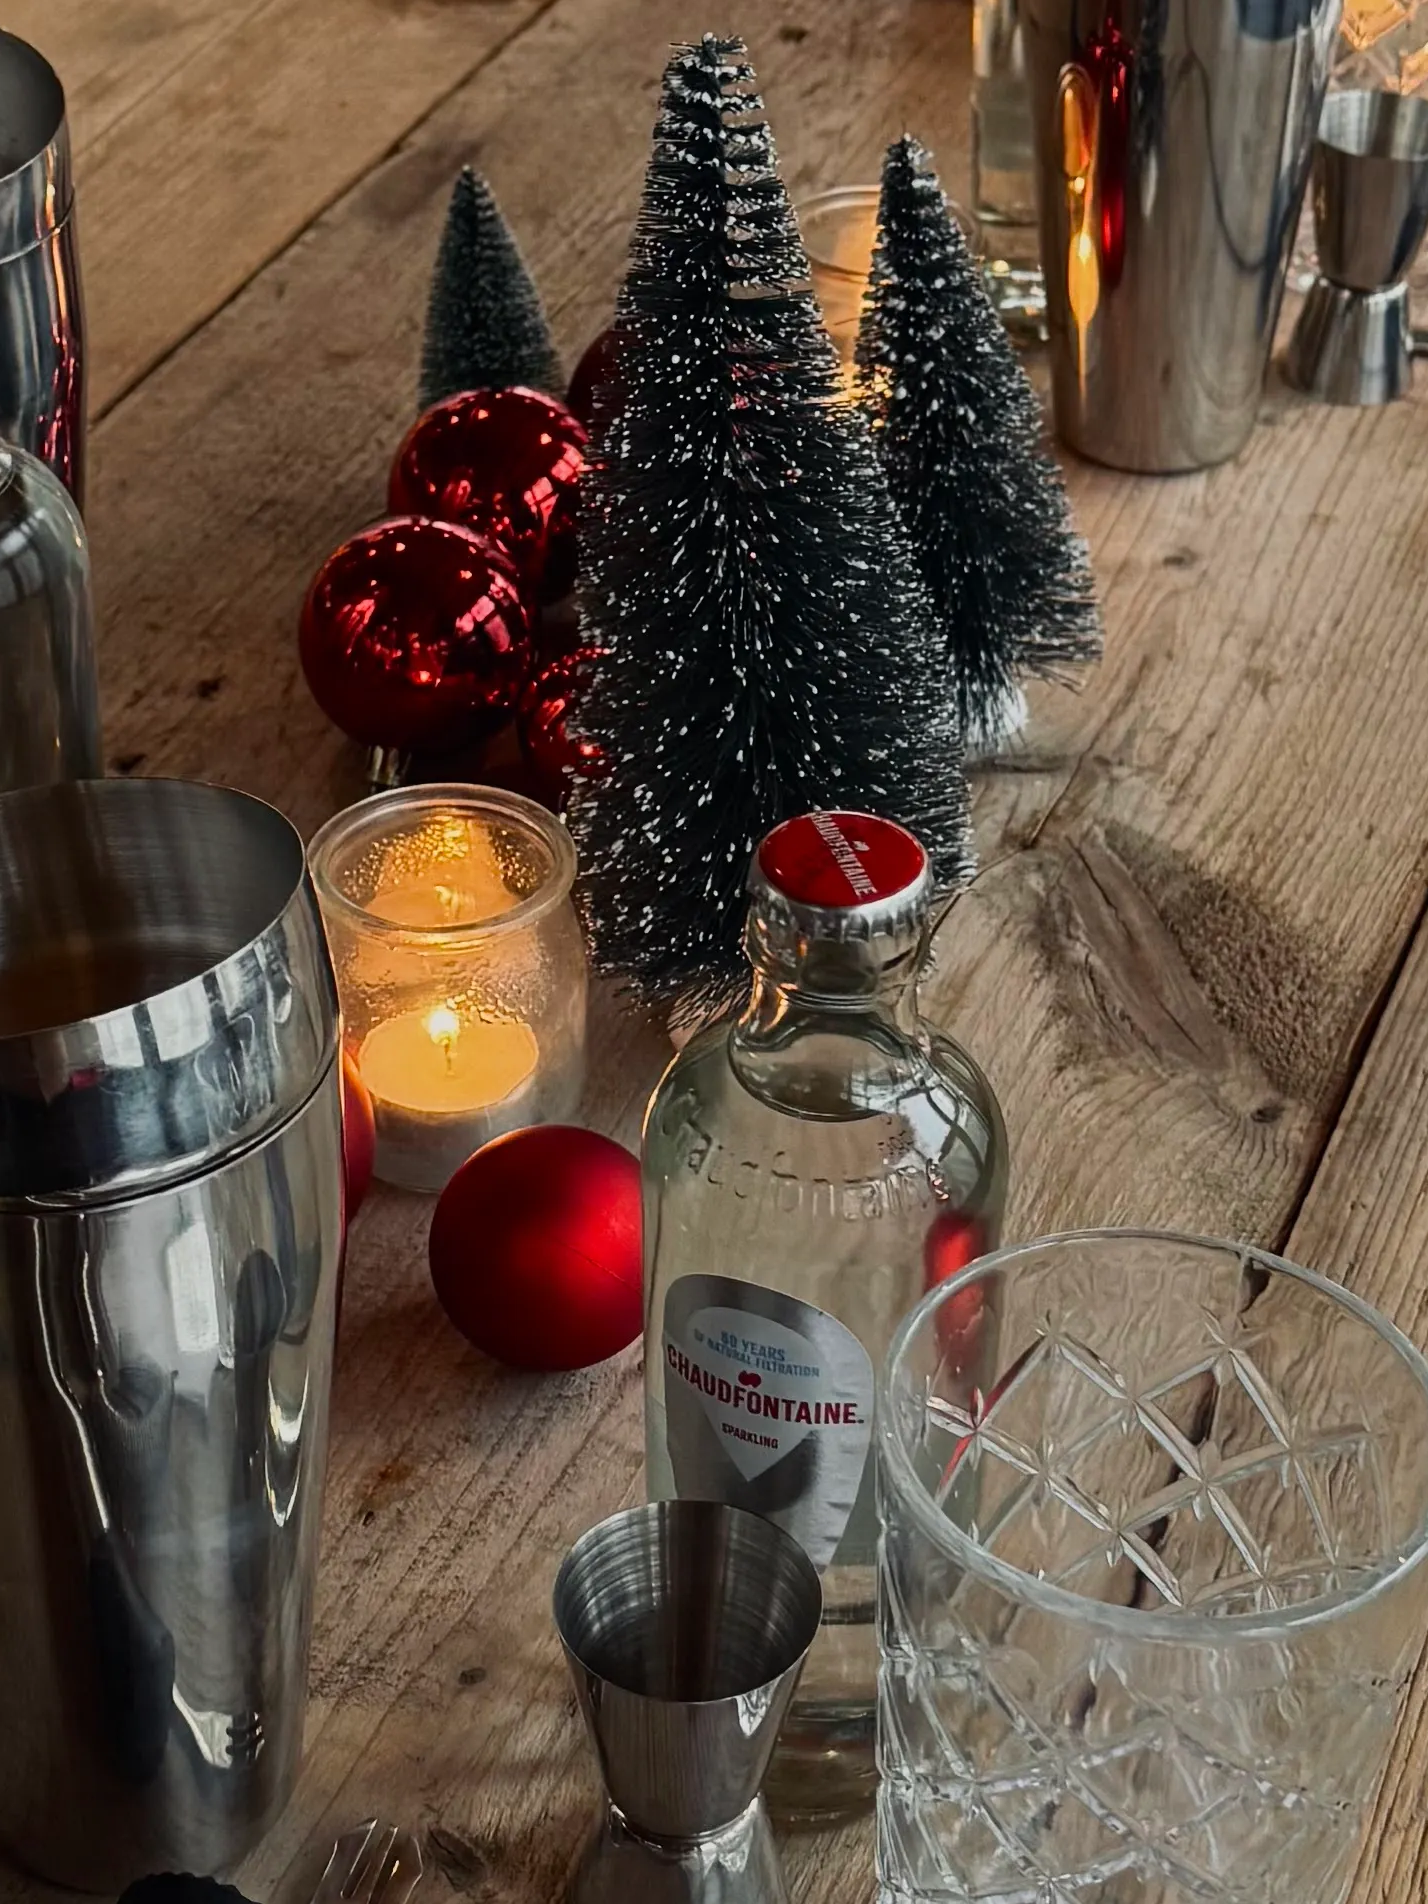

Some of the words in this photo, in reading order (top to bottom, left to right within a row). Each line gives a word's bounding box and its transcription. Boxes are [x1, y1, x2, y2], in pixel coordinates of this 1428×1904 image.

[741, 1334, 786, 1362] YEARS
[755, 1358, 820, 1378] FILTRATION
[721, 1422, 779, 1450] SPARKLING
